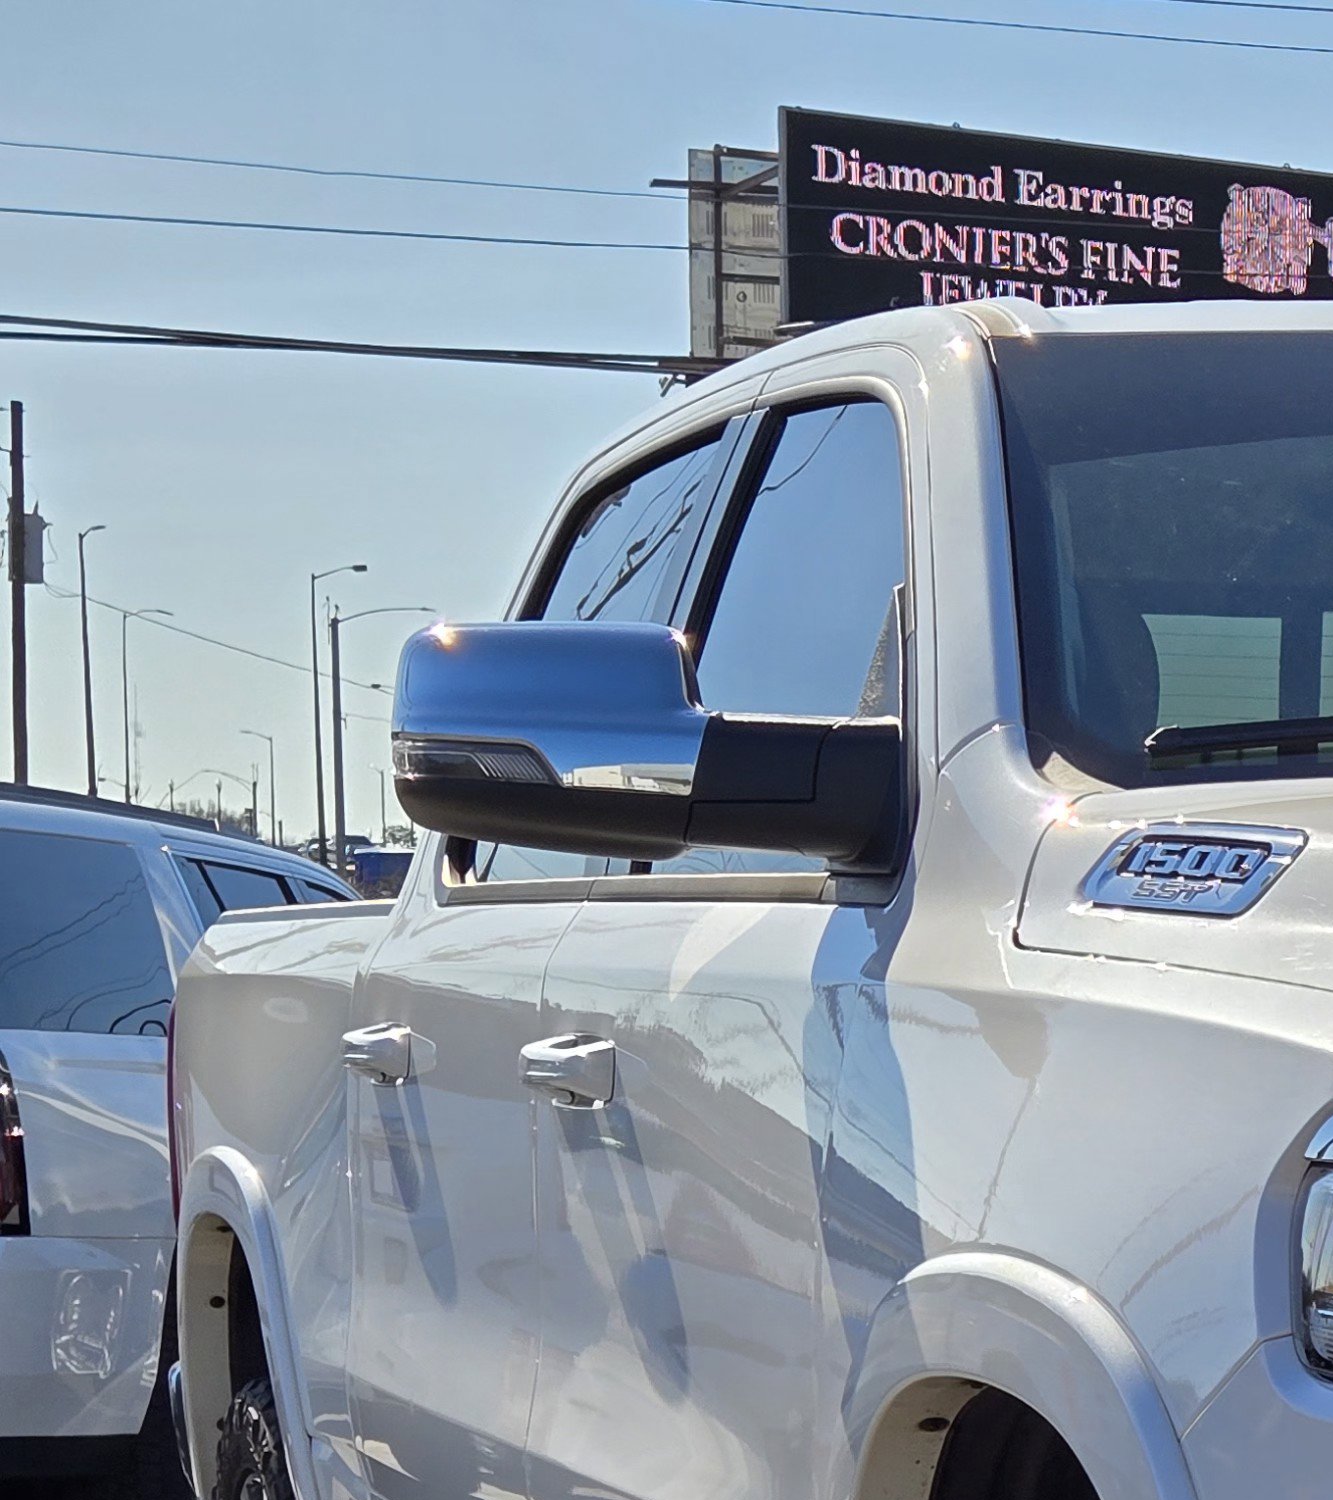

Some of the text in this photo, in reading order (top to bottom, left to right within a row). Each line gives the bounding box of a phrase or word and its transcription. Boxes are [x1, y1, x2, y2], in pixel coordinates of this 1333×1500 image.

[811, 143, 1194, 230] Diamond Earrings
[829, 212, 1182, 288] CRONIER'S FINE
[1126, 840, 1265, 880] 1500
